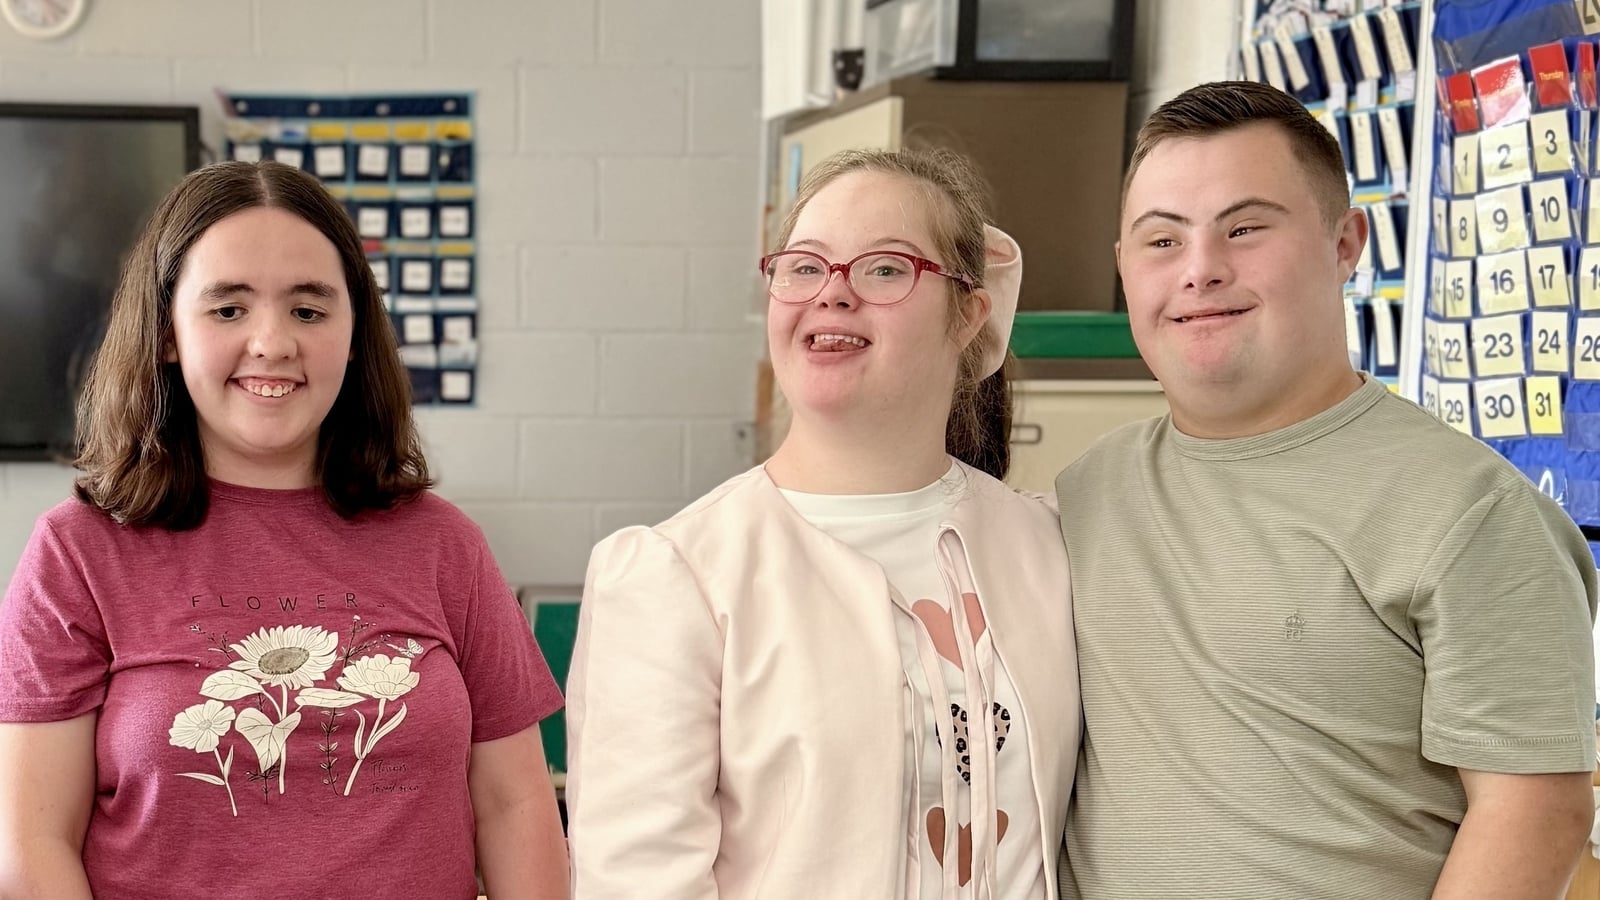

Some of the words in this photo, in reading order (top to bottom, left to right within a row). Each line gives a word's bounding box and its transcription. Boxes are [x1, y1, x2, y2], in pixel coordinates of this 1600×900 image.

[1462, 152, 1469, 176] 1
[1497, 144, 1513, 170] 2
[1544, 129, 1558, 156] 3
[1459, 217, 1468, 241] 8
[1492, 208, 1508, 233] 9
[1540, 196, 1560, 223] 10
[1451, 277, 1465, 302] 15
[1490, 268, 1515, 295] 16
[1538, 264, 1556, 290] 17
[1444, 338, 1463, 364] 22
[1483, 332, 1515, 359] 23
[1537, 328, 1561, 355] 24
[1445, 399, 1465, 424] 29
[1484, 394, 1515, 420] 30
[1534, 391, 1552, 418] 31
[192, 592, 386, 612] FLOWER
